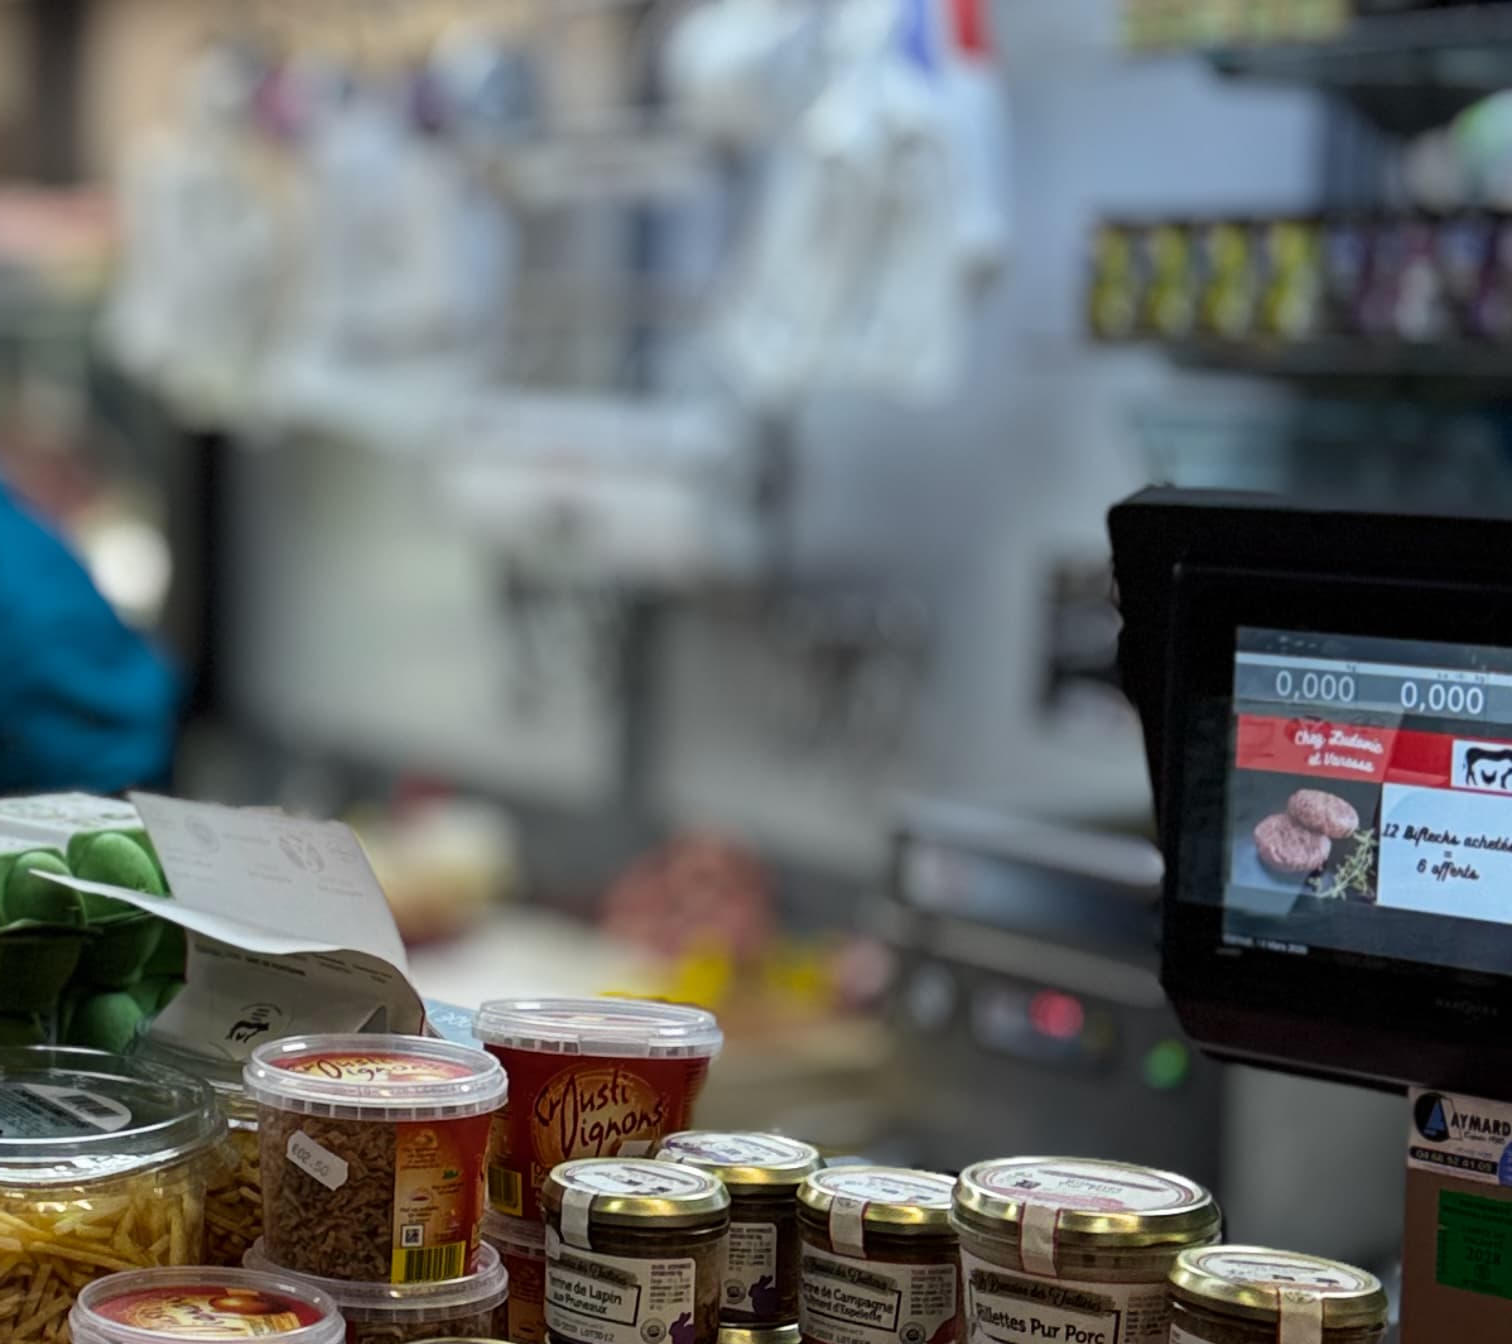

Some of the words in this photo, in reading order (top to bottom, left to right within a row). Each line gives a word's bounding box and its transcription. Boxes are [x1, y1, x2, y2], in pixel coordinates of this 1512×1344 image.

[1275, 670, 1357, 703] 0,000
[1400, 681, 1485, 715] 0,000
[1383, 822, 1400, 839] 12
[1416, 858, 1428, 874] 6
[1450, 1111, 1512, 1137] AYMARD
[589, 1284, 623, 1306] Lapin
[833, 1289, 895, 1314] Campagne
[1029, 1317, 1061, 1340] Pur
